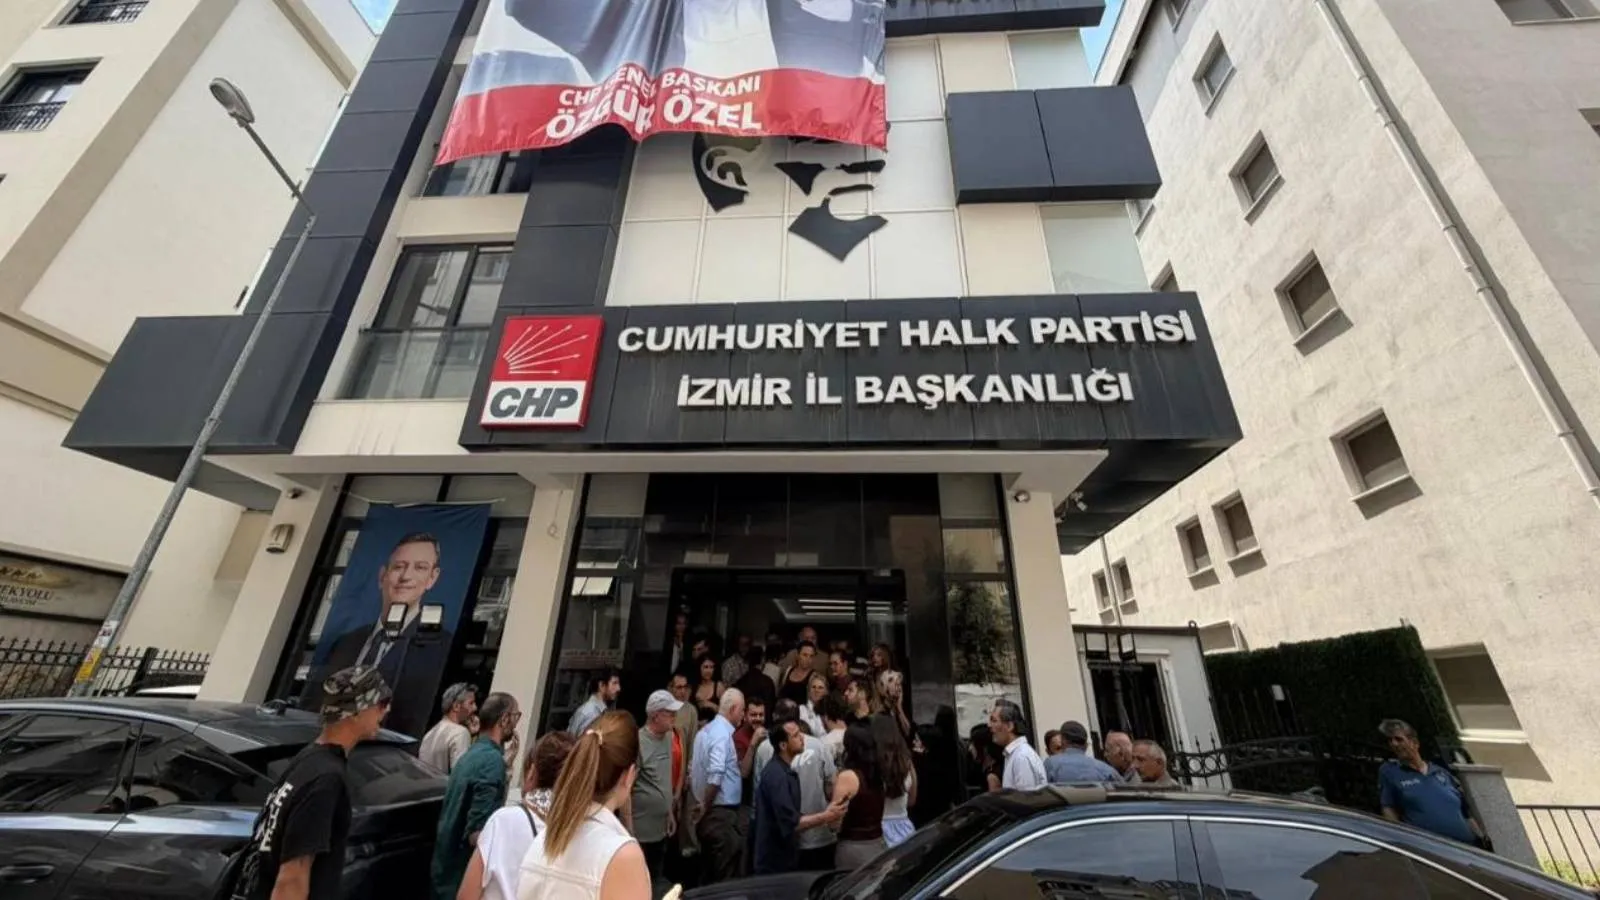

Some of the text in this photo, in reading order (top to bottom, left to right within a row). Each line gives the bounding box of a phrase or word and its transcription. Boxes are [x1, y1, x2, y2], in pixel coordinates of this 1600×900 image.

[559, 88, 602, 106] CHP
[663, 88, 763, 130] ÖZEL
[617, 309, 1197, 352] CUMHURİYET HALK PARTİSİ
[489, 386, 580, 419] CHP
[677, 367, 1135, 410] İZMİR İL BAŞKANLIĞI
[0, 584, 55, 601] EKYOLU
